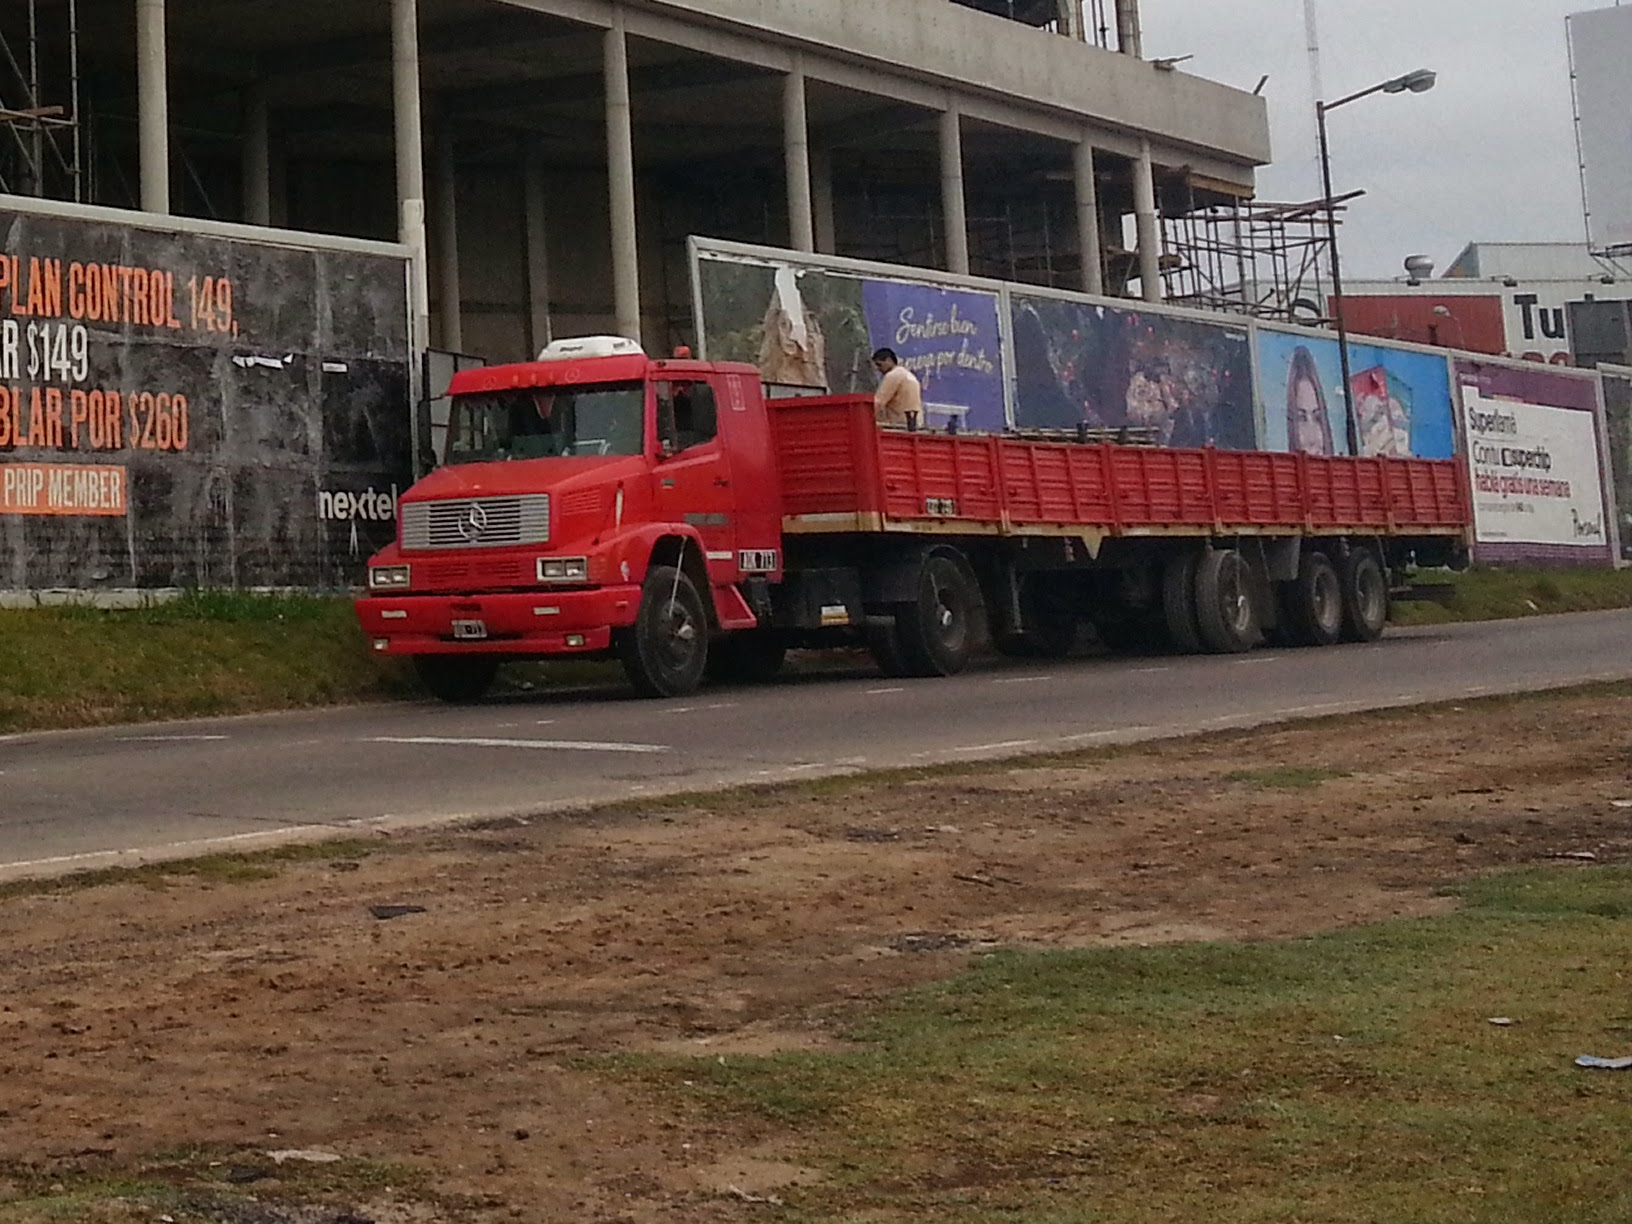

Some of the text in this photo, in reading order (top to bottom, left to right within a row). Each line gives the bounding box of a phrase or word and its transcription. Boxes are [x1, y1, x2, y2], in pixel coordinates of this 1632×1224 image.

[69, 262, 180, 328] CONTROL
[188, 275, 238, 341] 149,
[27, 320, 88, 382] $149
[71, 389, 121, 449] POR
[128, 390, 188, 451] $260
[5, 468, 43, 507] PRIP
[48, 469, 121, 508] MEMBER
[319, 483, 397, 520] nextel
